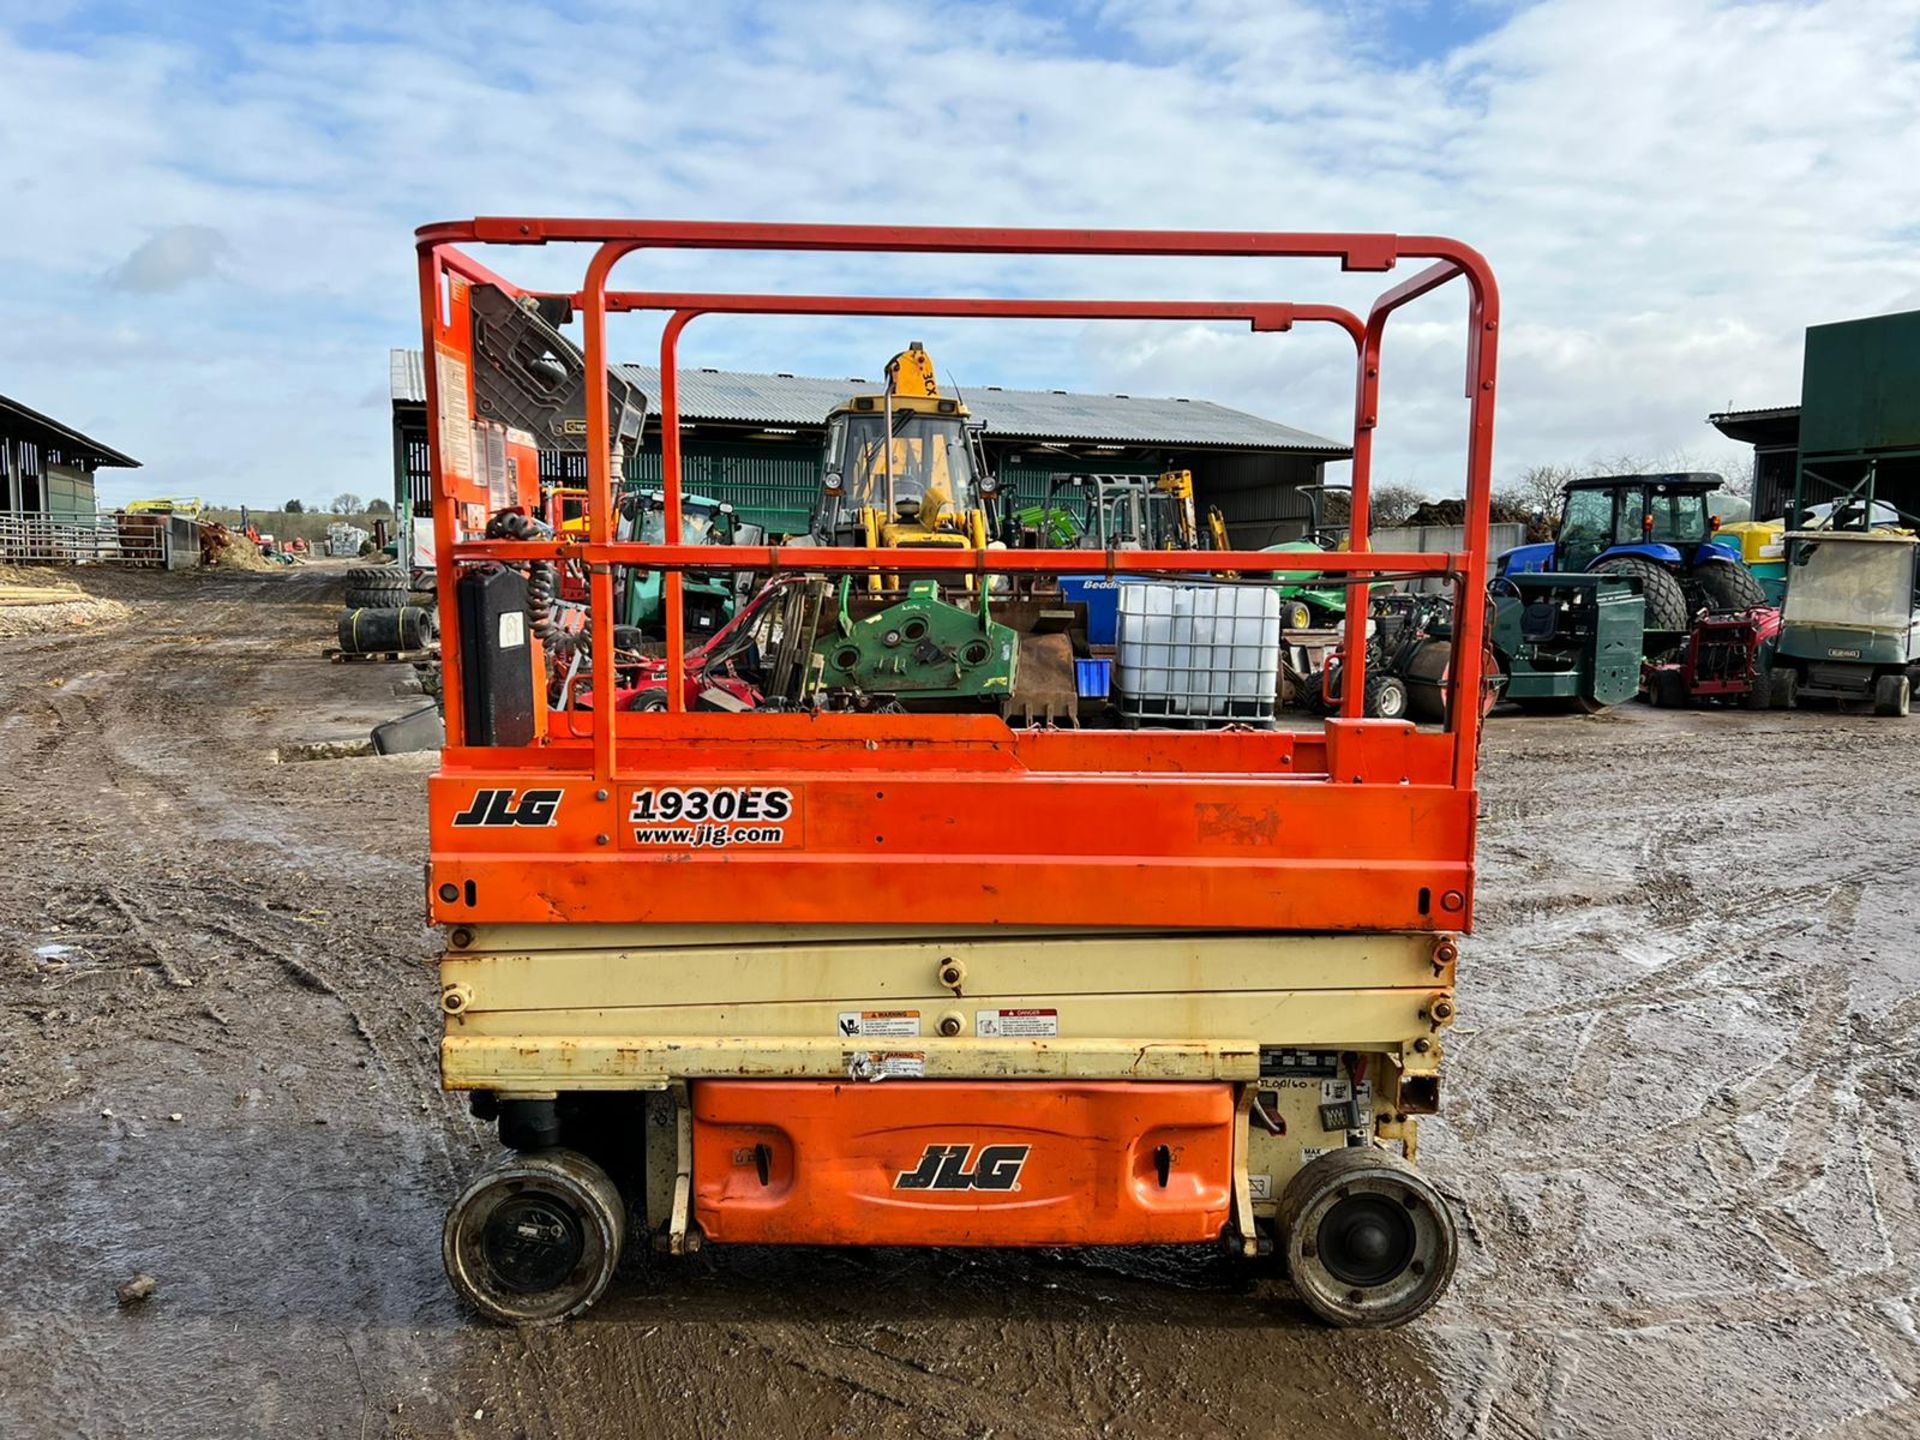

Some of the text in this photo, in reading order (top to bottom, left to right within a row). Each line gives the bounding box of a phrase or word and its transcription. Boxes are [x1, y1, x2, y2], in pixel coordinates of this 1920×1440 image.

[922, 372, 937, 396] 3CX
[452, 788, 565, 826] JLG
[632, 789, 792, 822] 1930ES
[634, 826, 783, 848] www.jlg.com
[893, 1144, 1032, 1191] JLG
